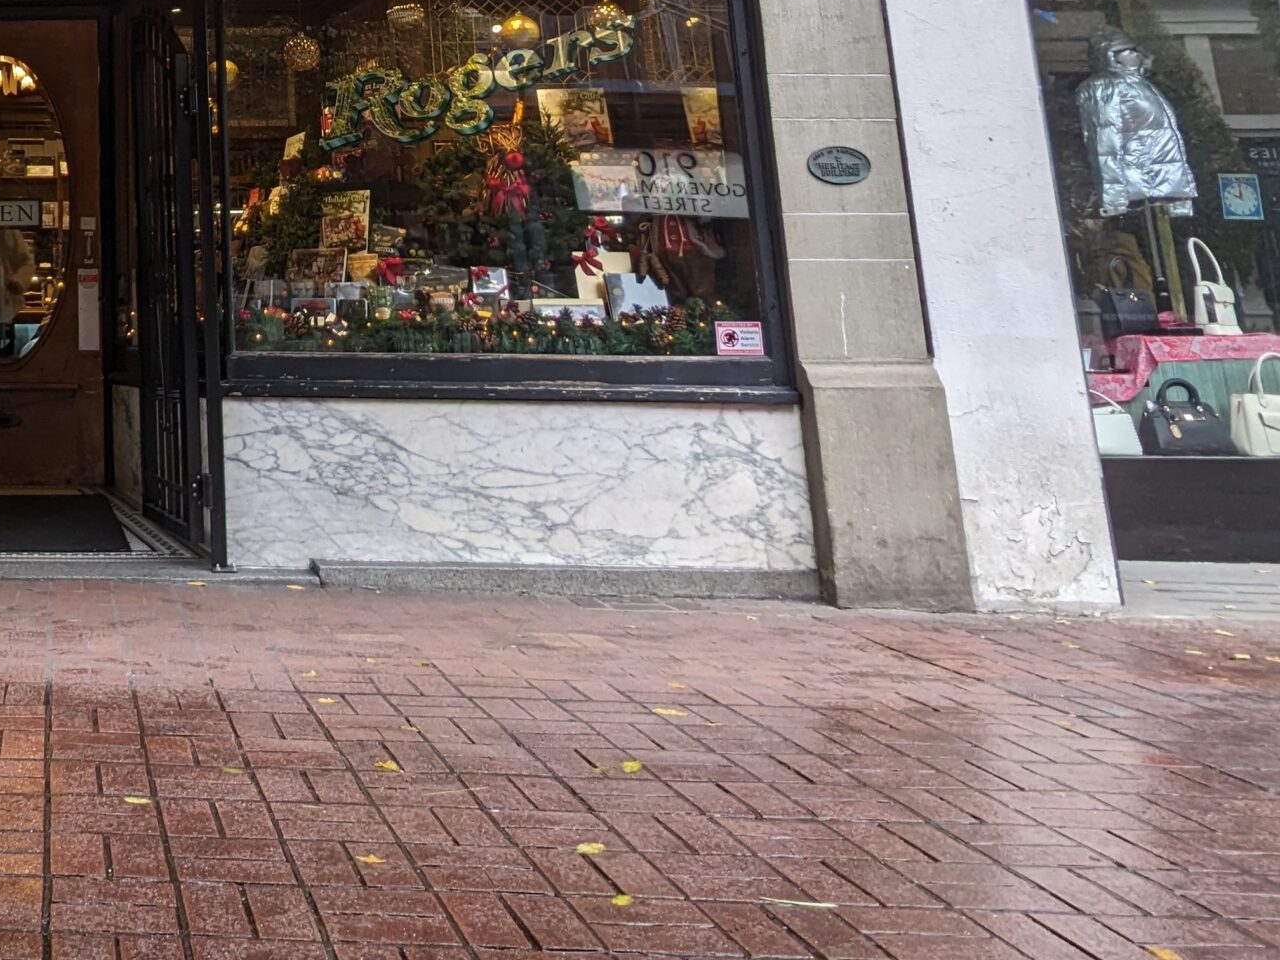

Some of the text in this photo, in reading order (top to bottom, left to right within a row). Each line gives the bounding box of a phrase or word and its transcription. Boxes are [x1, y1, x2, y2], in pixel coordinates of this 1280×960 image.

[319, 15, 636, 152] Rogers
[816, 162, 861, 170] HERITAGE
[821, 169, 861, 177] BUILDING
